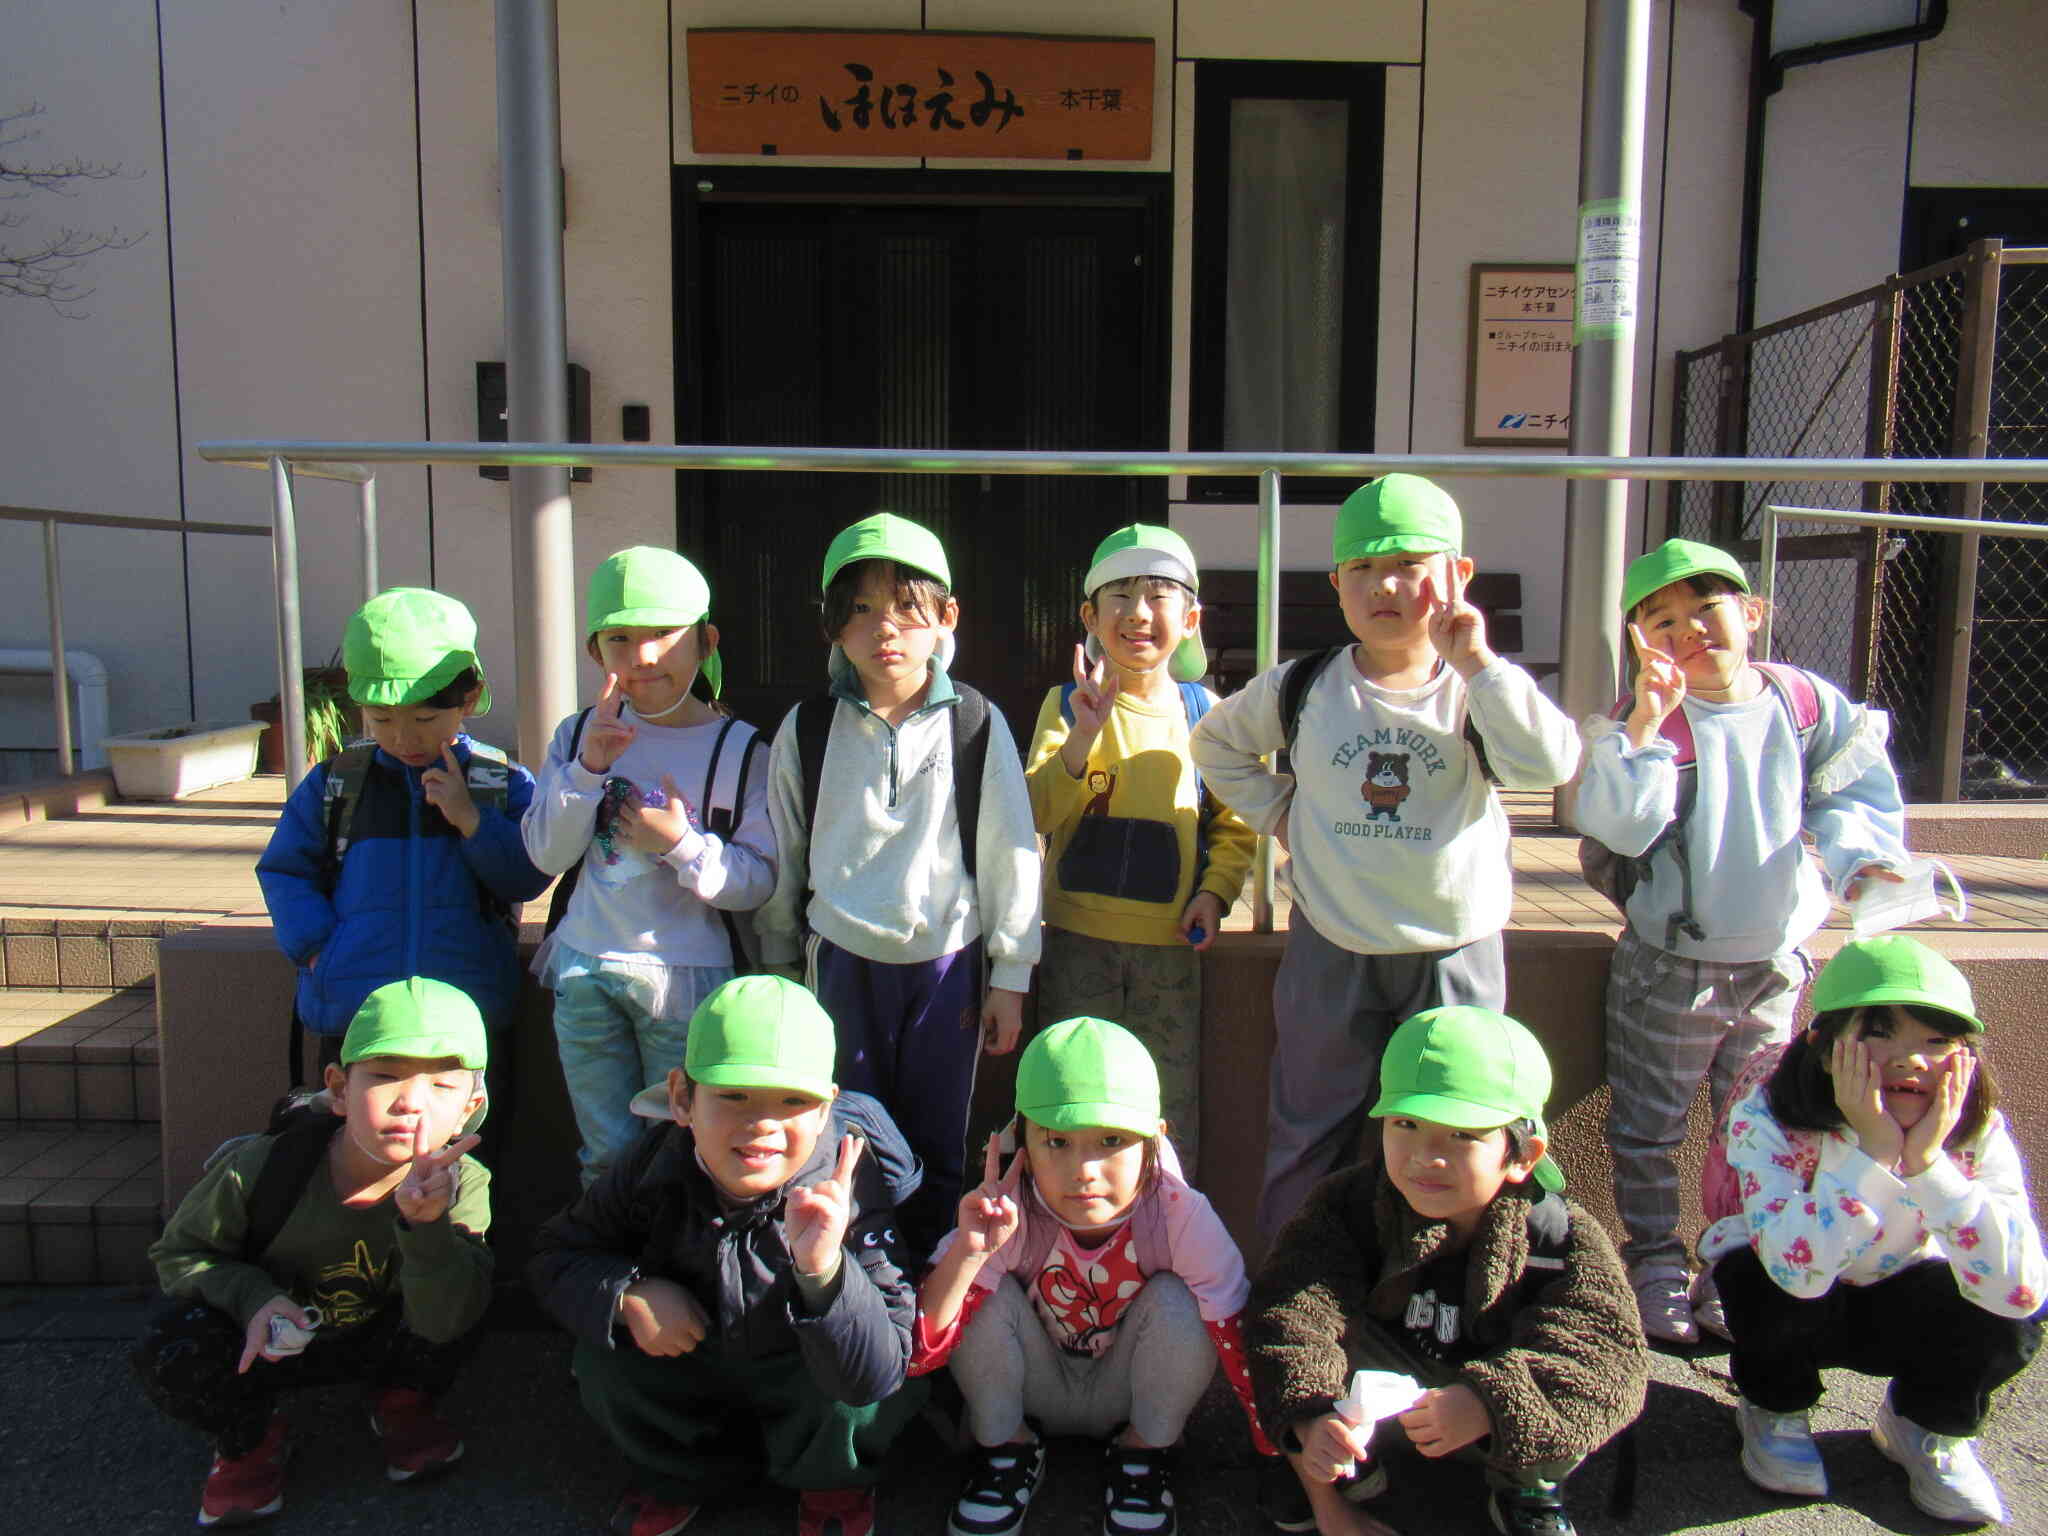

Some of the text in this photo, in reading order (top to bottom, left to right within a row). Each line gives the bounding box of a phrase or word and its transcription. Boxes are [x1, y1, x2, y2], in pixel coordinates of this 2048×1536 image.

[721, 62, 1123, 134] ニチイの ほほえみ 本千葉
[1334, 821, 1432, 841] GOOD PLAYER
